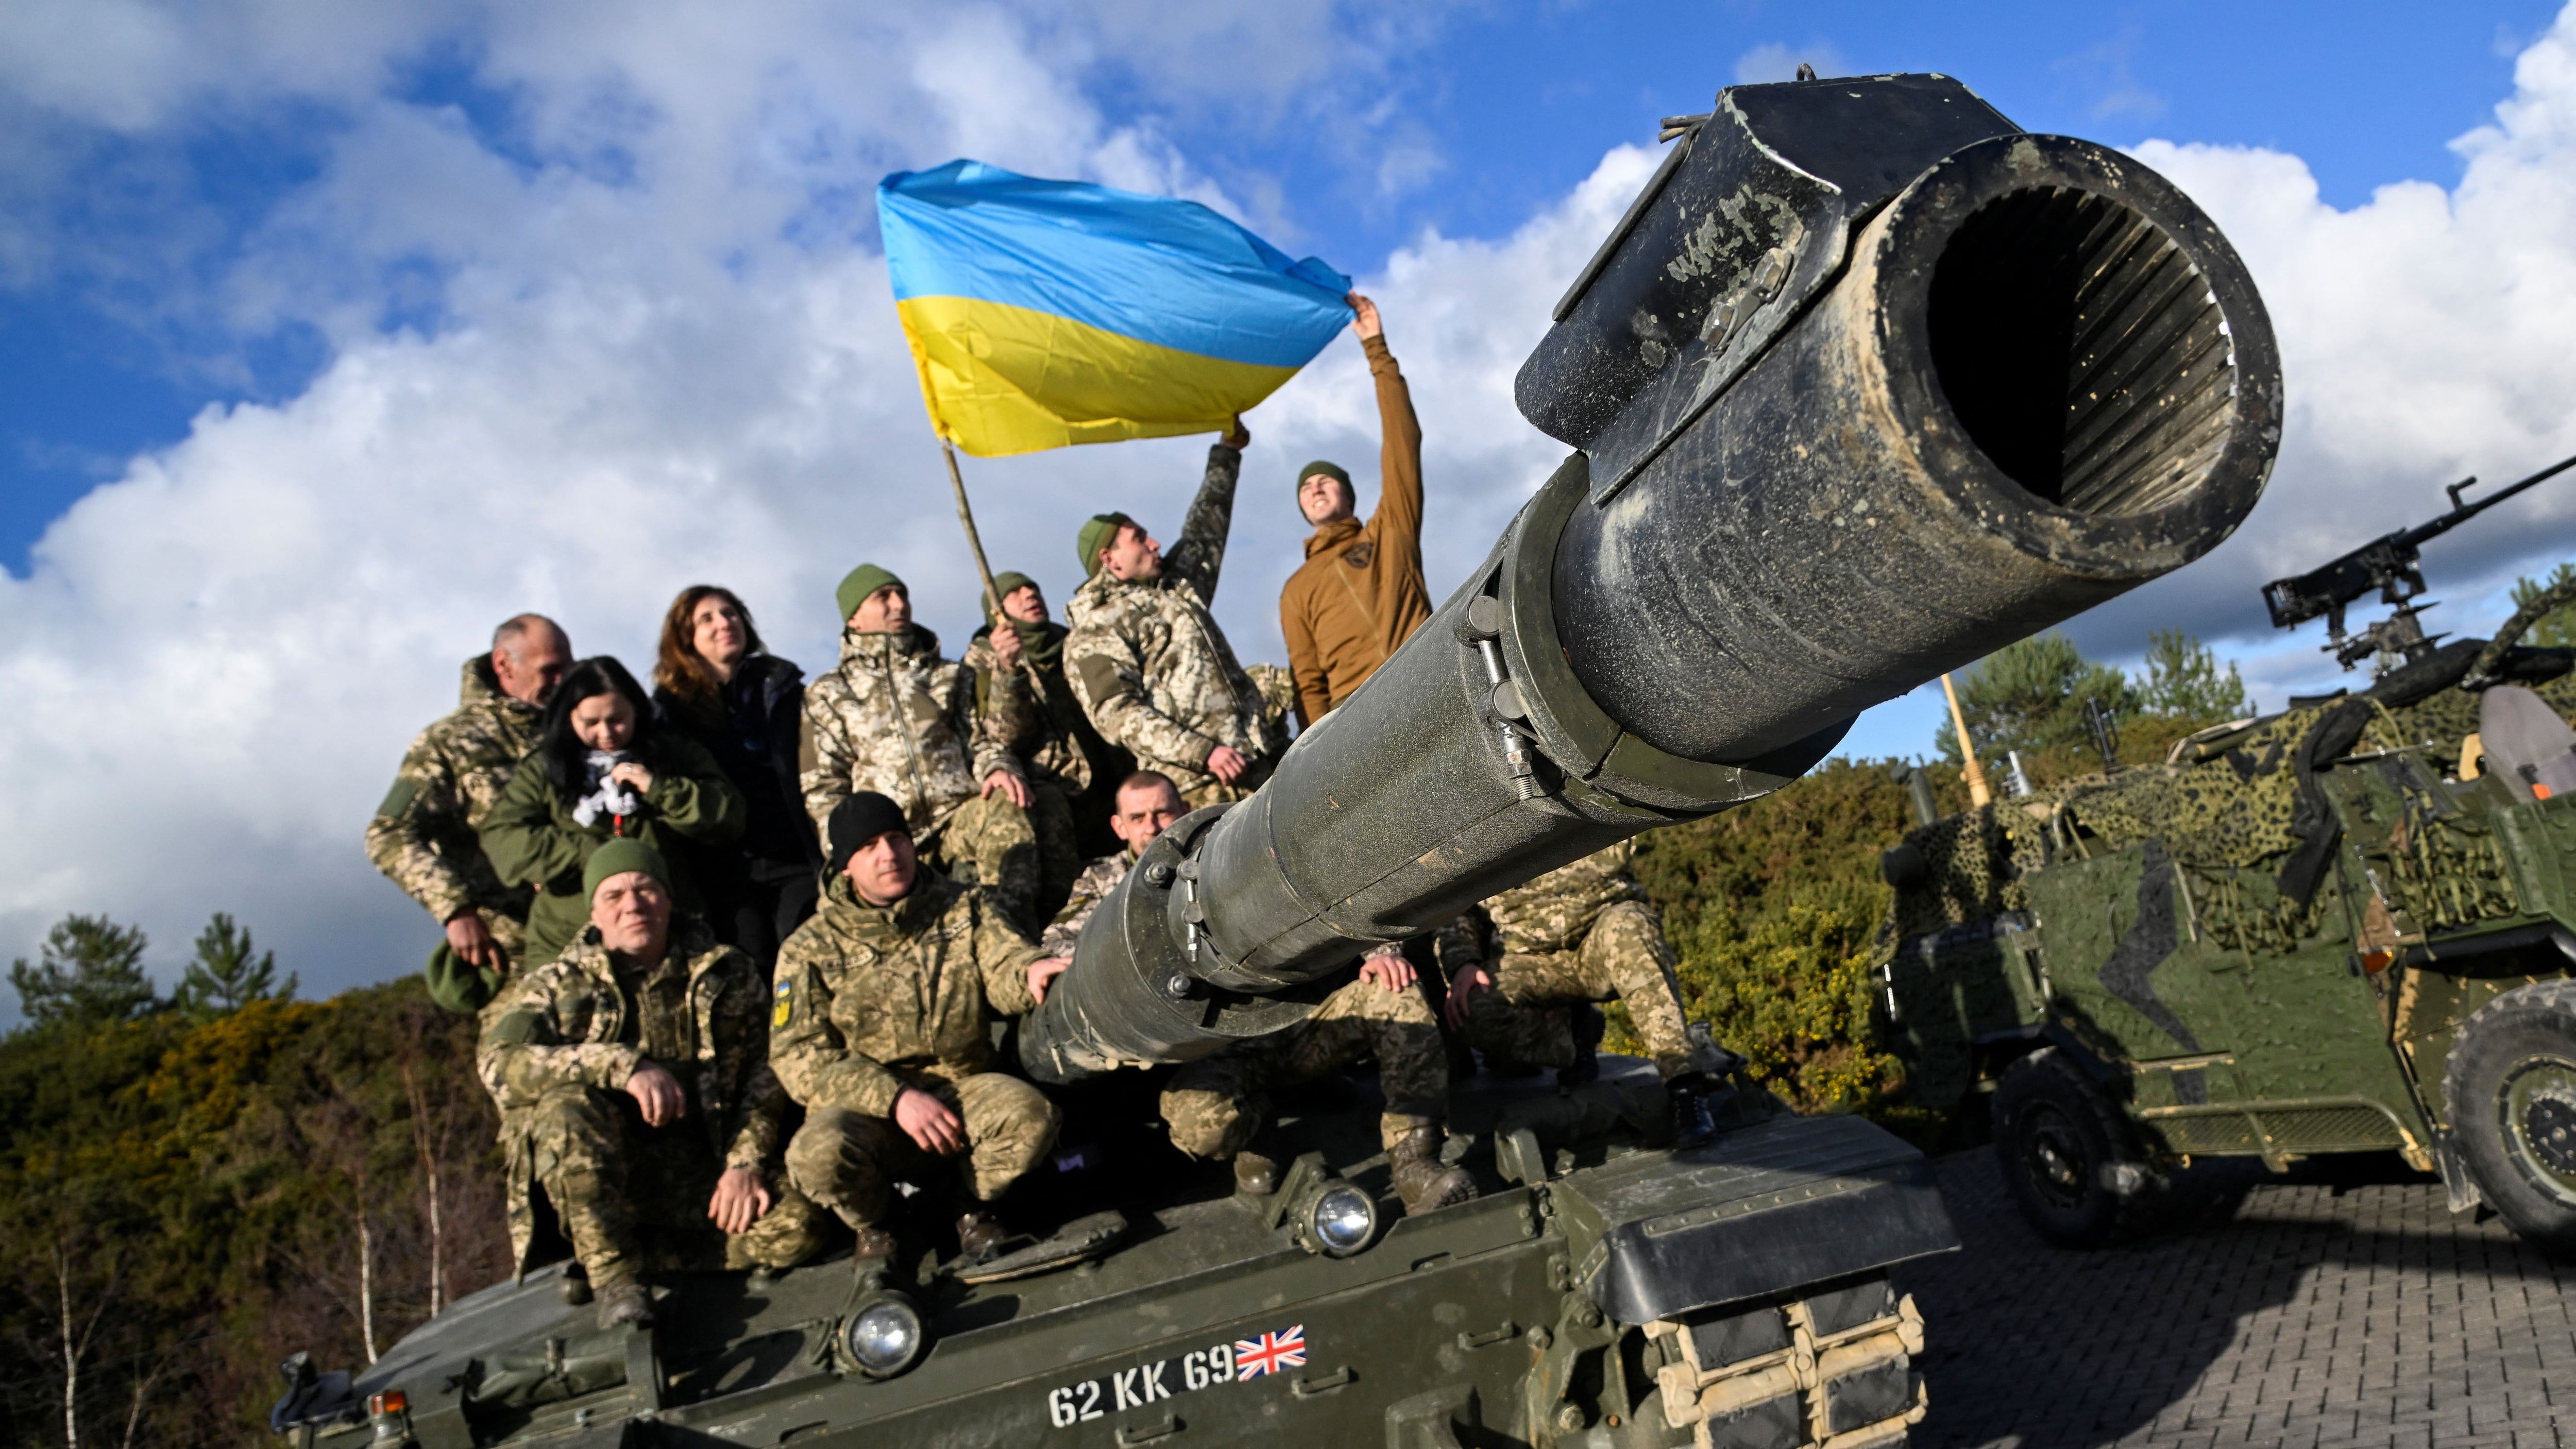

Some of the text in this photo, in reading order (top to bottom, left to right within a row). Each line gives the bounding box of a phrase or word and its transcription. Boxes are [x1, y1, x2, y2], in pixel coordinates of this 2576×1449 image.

[1048, 1344, 1234, 1427] 62 KK 69
